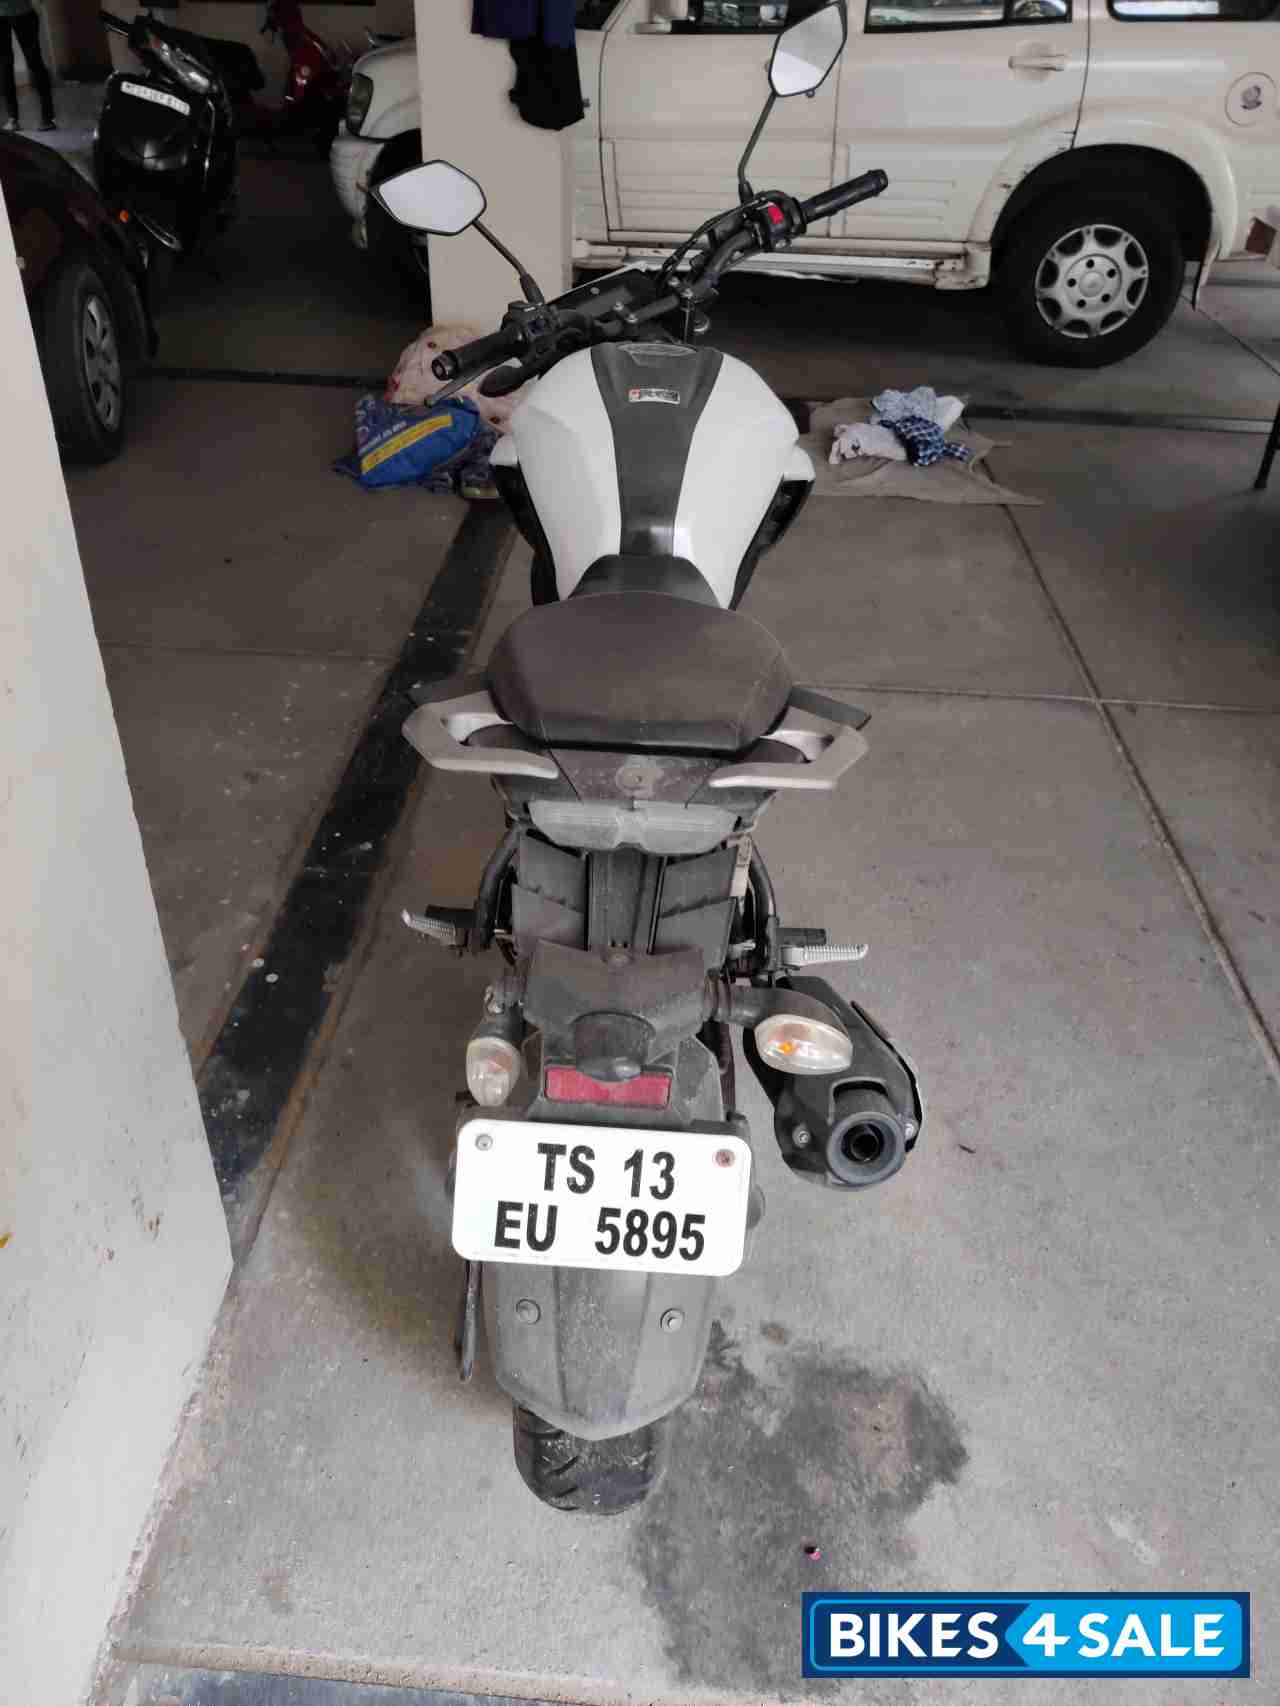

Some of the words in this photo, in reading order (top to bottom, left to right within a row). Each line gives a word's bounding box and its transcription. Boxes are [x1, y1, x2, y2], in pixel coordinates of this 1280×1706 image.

[538, 1142, 595, 1194] TS
[624, 1149, 675, 1200] 13
[494, 1200, 558, 1252] EU
[594, 1207, 706, 1261] 5895
